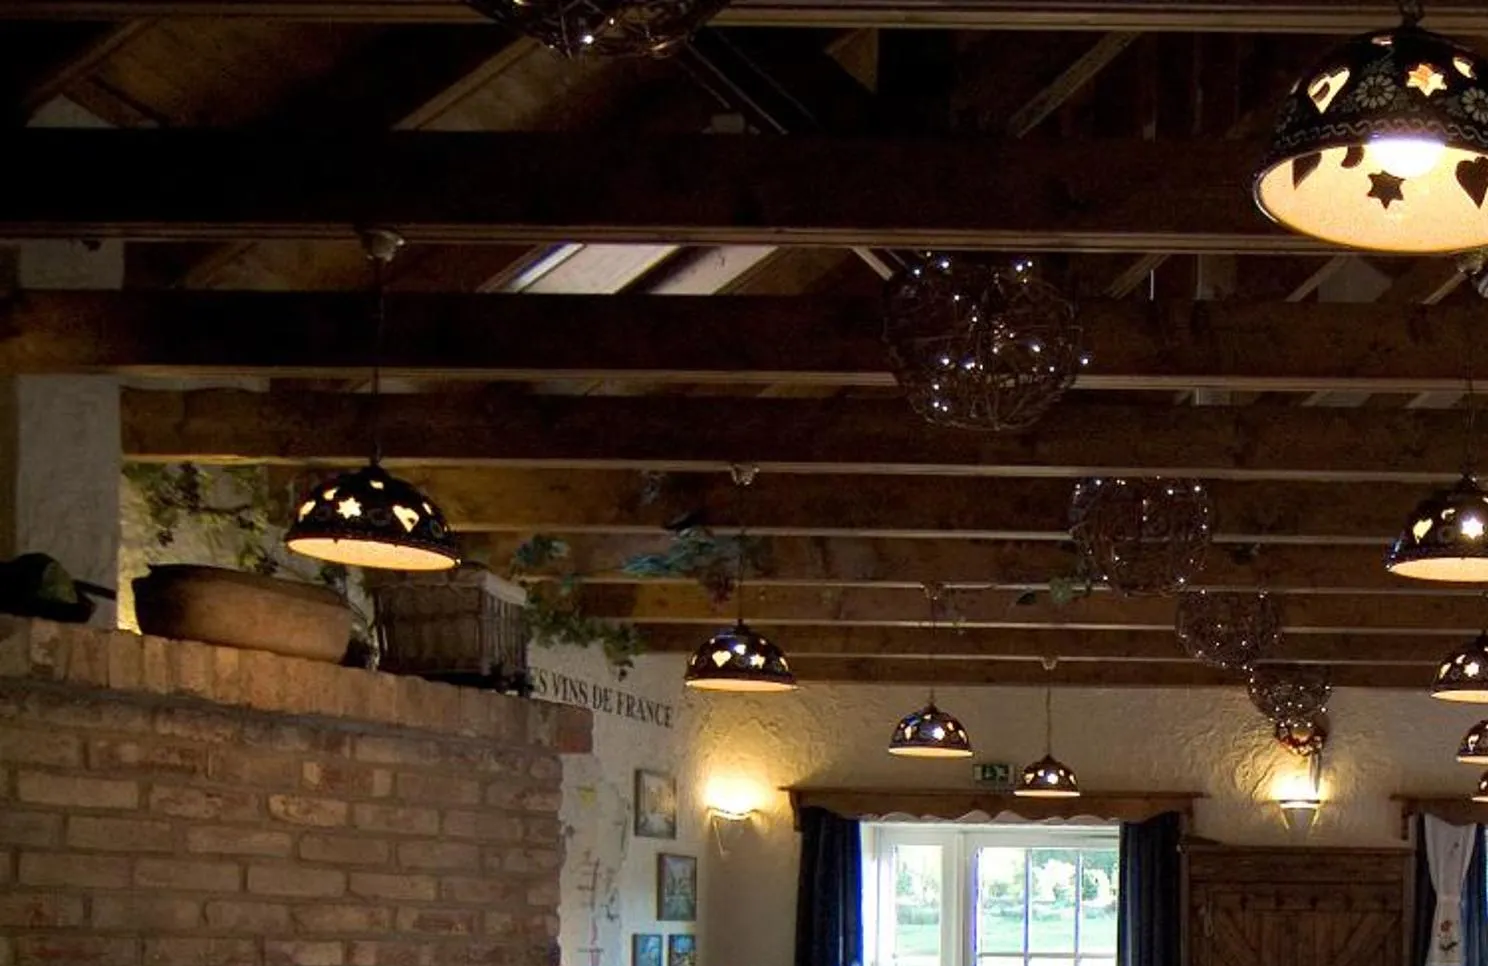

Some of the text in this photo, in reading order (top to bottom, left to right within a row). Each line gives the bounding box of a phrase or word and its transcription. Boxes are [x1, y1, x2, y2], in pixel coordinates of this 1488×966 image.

[552, 671, 588, 704] VINS
[592, 684, 614, 714] DE
[615, 690, 673, 729] FRANCE
